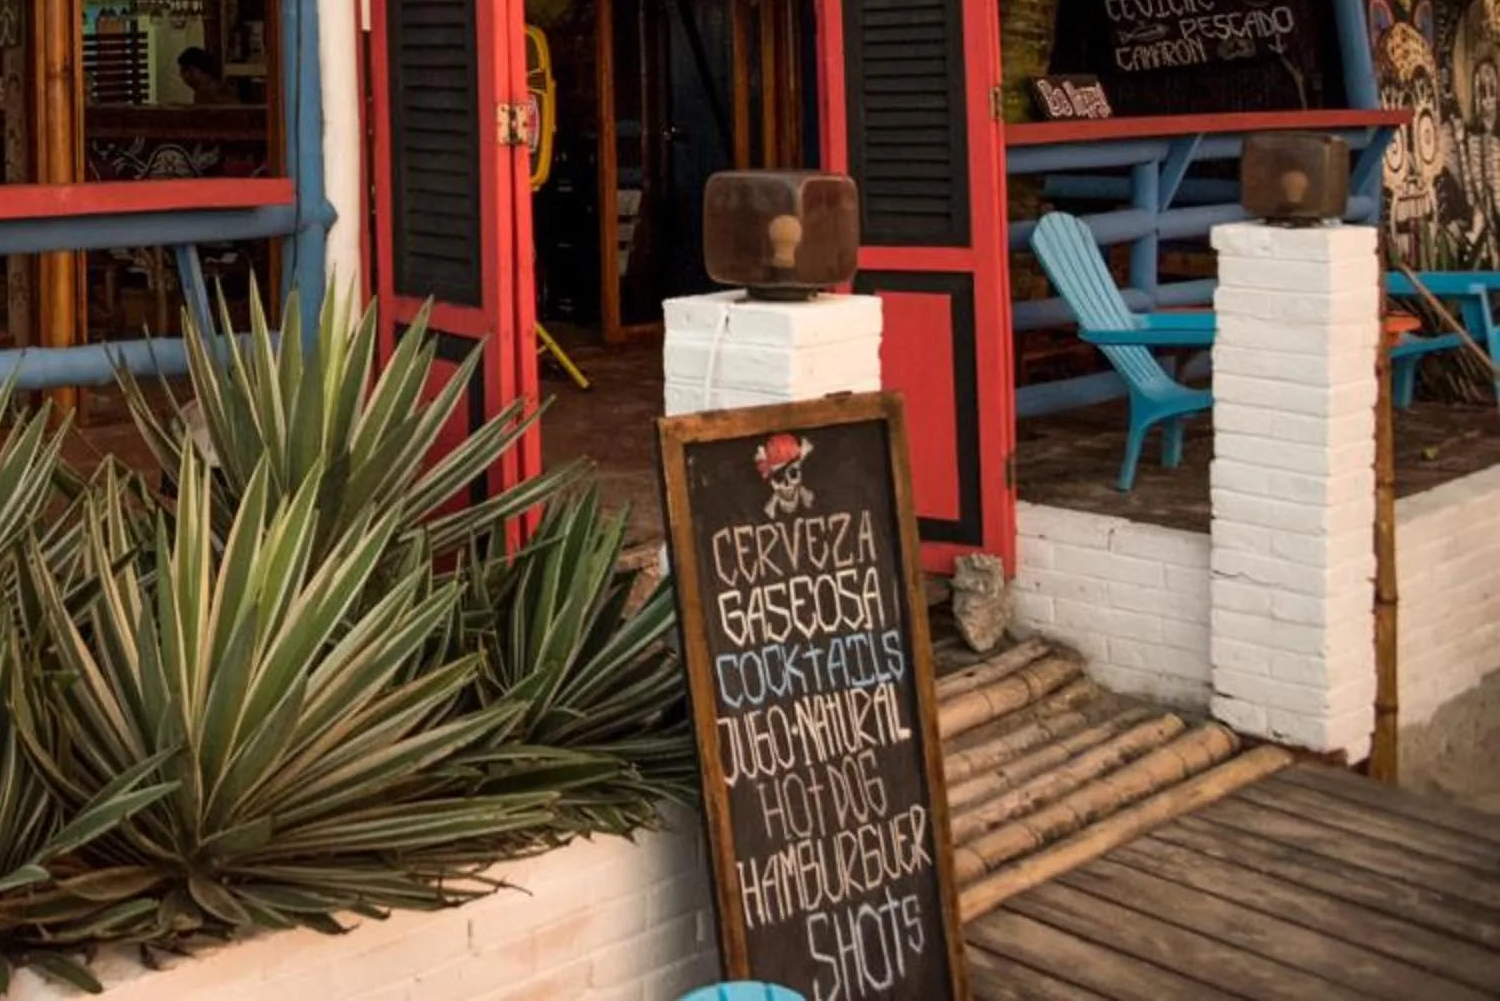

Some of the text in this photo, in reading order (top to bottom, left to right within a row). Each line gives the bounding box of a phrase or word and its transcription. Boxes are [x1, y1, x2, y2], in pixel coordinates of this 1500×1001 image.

[1115, 35, 1208, 72] CAMARON
[1179, 6, 1295, 40] PESCADO
[712, 510, 877, 586] CERVEZA
[717, 566, 886, 648] GASEOSA
[826, 749, 889, 829] DOG
[735, 803, 933, 930] HAMBURGUER
